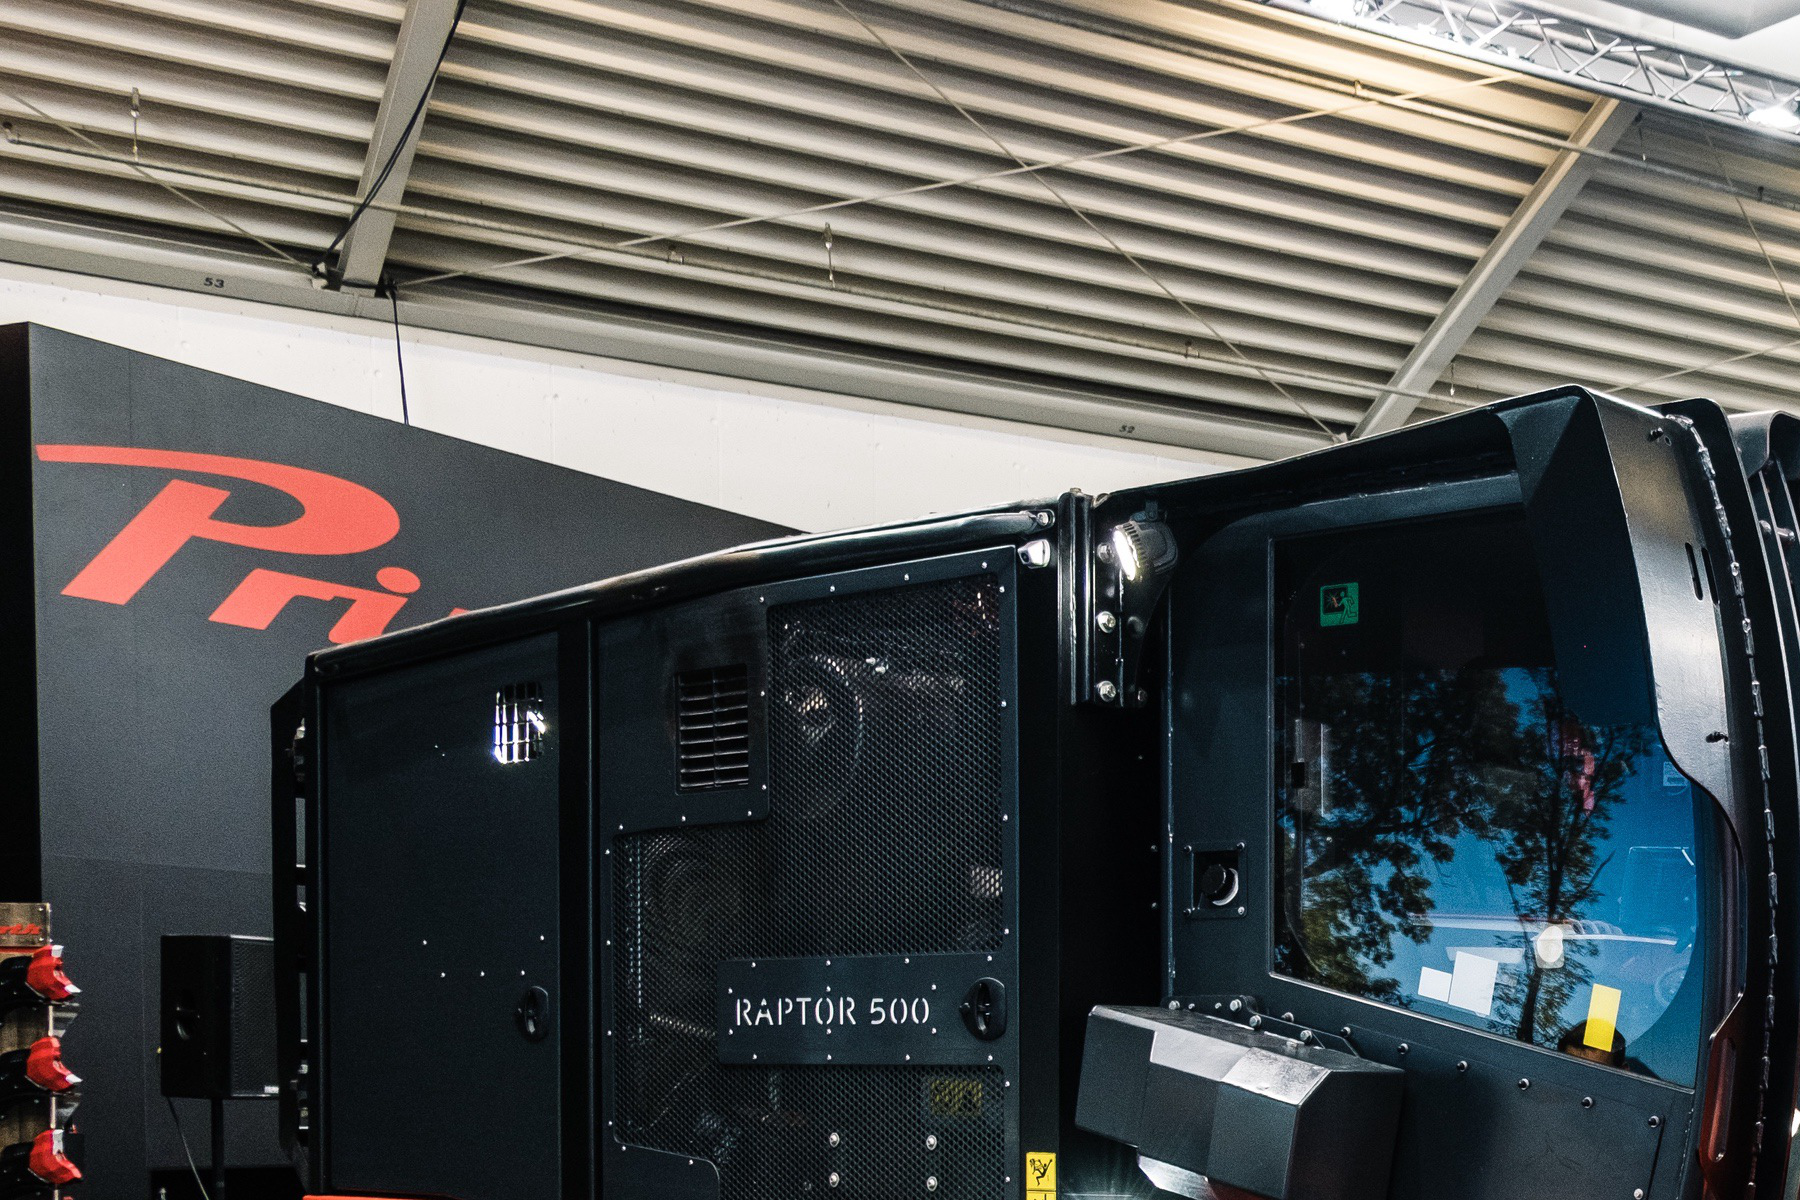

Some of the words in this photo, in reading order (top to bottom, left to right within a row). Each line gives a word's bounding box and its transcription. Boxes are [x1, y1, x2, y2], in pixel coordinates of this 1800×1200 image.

[203, 277, 224, 288] 53
[35, 444, 471, 645] Pri
[735, 997, 857, 1026] RAPTOR
[869, 996, 931, 1025] 500
